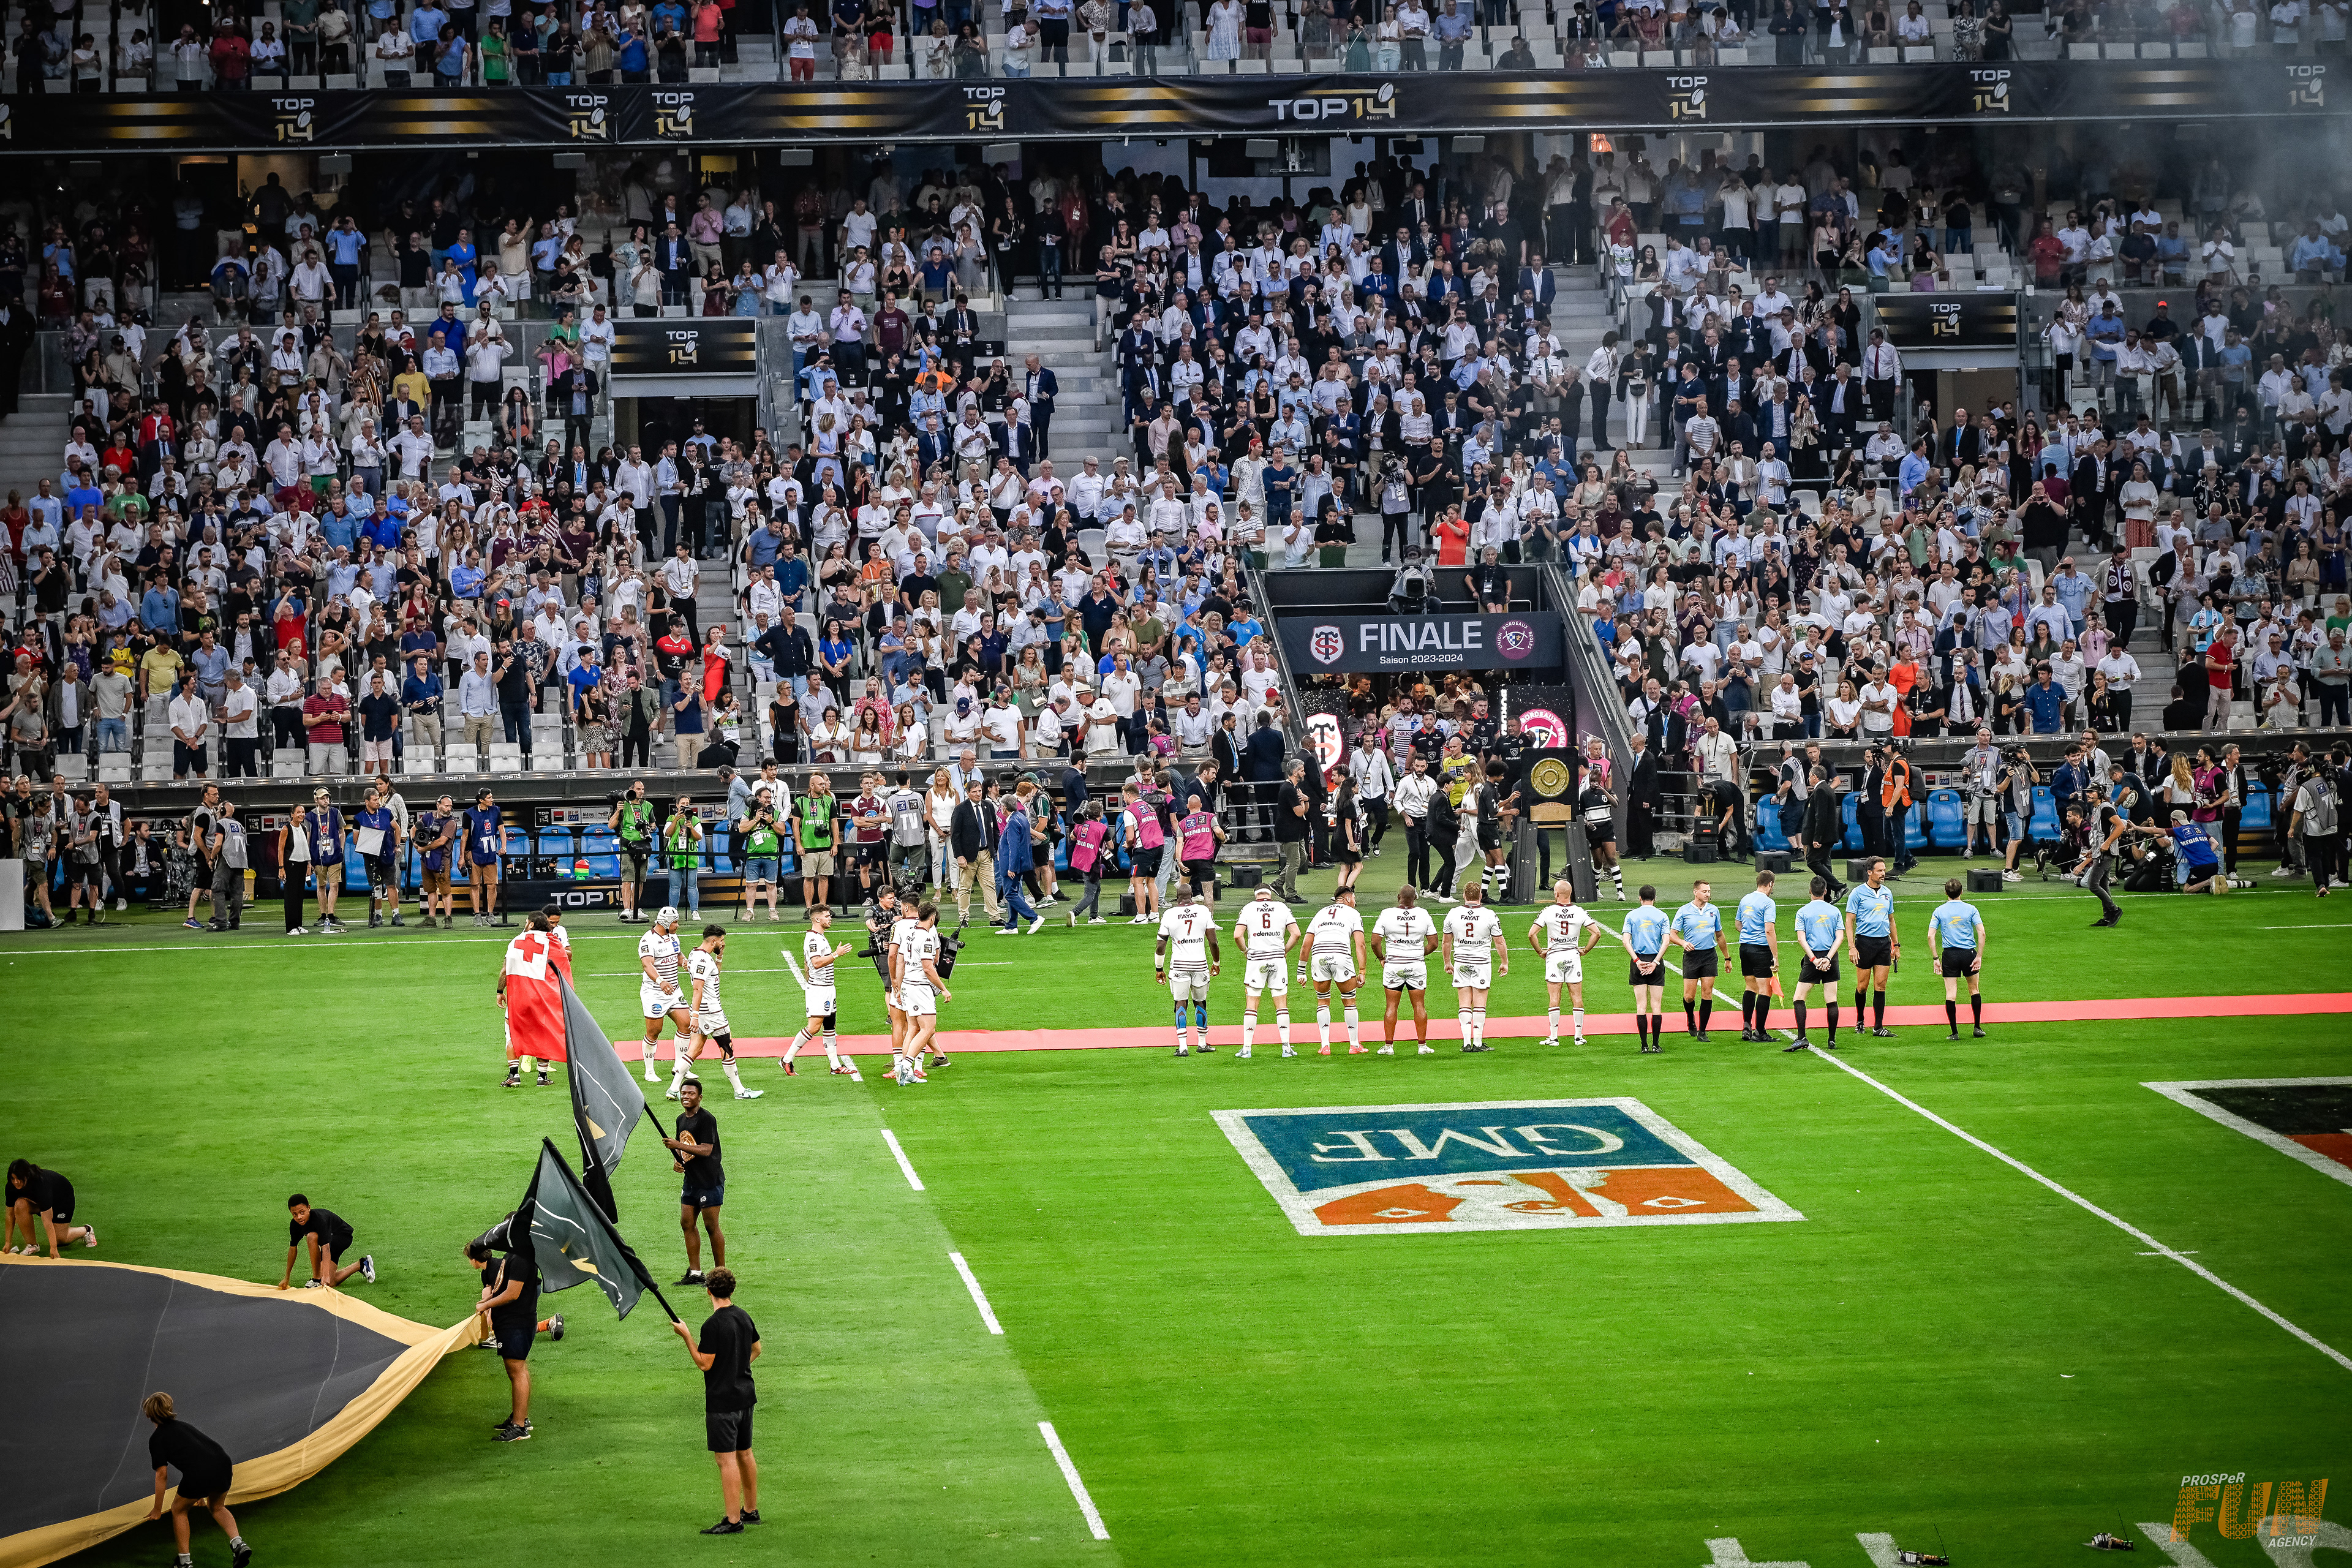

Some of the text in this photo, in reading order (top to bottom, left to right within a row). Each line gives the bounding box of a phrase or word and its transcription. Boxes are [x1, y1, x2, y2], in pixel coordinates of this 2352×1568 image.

[1970, 70, 2011, 81] TOP
[2285, 66, 2326, 77] TOP
[1667, 76, 1708, 88] TOP
[651, 92, 694, 104] TOP
[963, 87, 1006, 99] TOP
[271, 99, 314, 110] TOP
[565, 95, 608, 107] TOP
[1972, 94, 2009, 112] 14
[1669, 101, 1706, 119] 14
[654, 118, 693, 135] 14
[965, 111, 1004, 130] 14
[275, 123, 313, 141] 14
[568, 120, 606, 138] 14
[1930, 303, 1961, 312] TOP
[666, 331, 698, 341] TOP
[1932, 322, 1959, 336] 14
[668, 350, 697, 364] 14
[1502, 620, 1529, 630] BORDEAUX
[1360, 620, 1482, 652] FINALE
[1379, 654, 1463, 664] Saison 2023-2024
[1520, 710, 1558, 724] BORDEAUX
[900, 812, 918, 830] TV
[480, 835, 496, 853] TV
[2180, 837, 2199, 846] MEDIA
[1329, 908, 1337, 919] 4
[1184, 919, 1193, 936] 7
[1262, 913, 1270, 929] 6
[1559, 921, 1569, 935] 9
[1404, 922, 1409, 937] 1
[1466, 922, 1474, 937] 2
[1310, 1123, 1624, 1163] GMF
